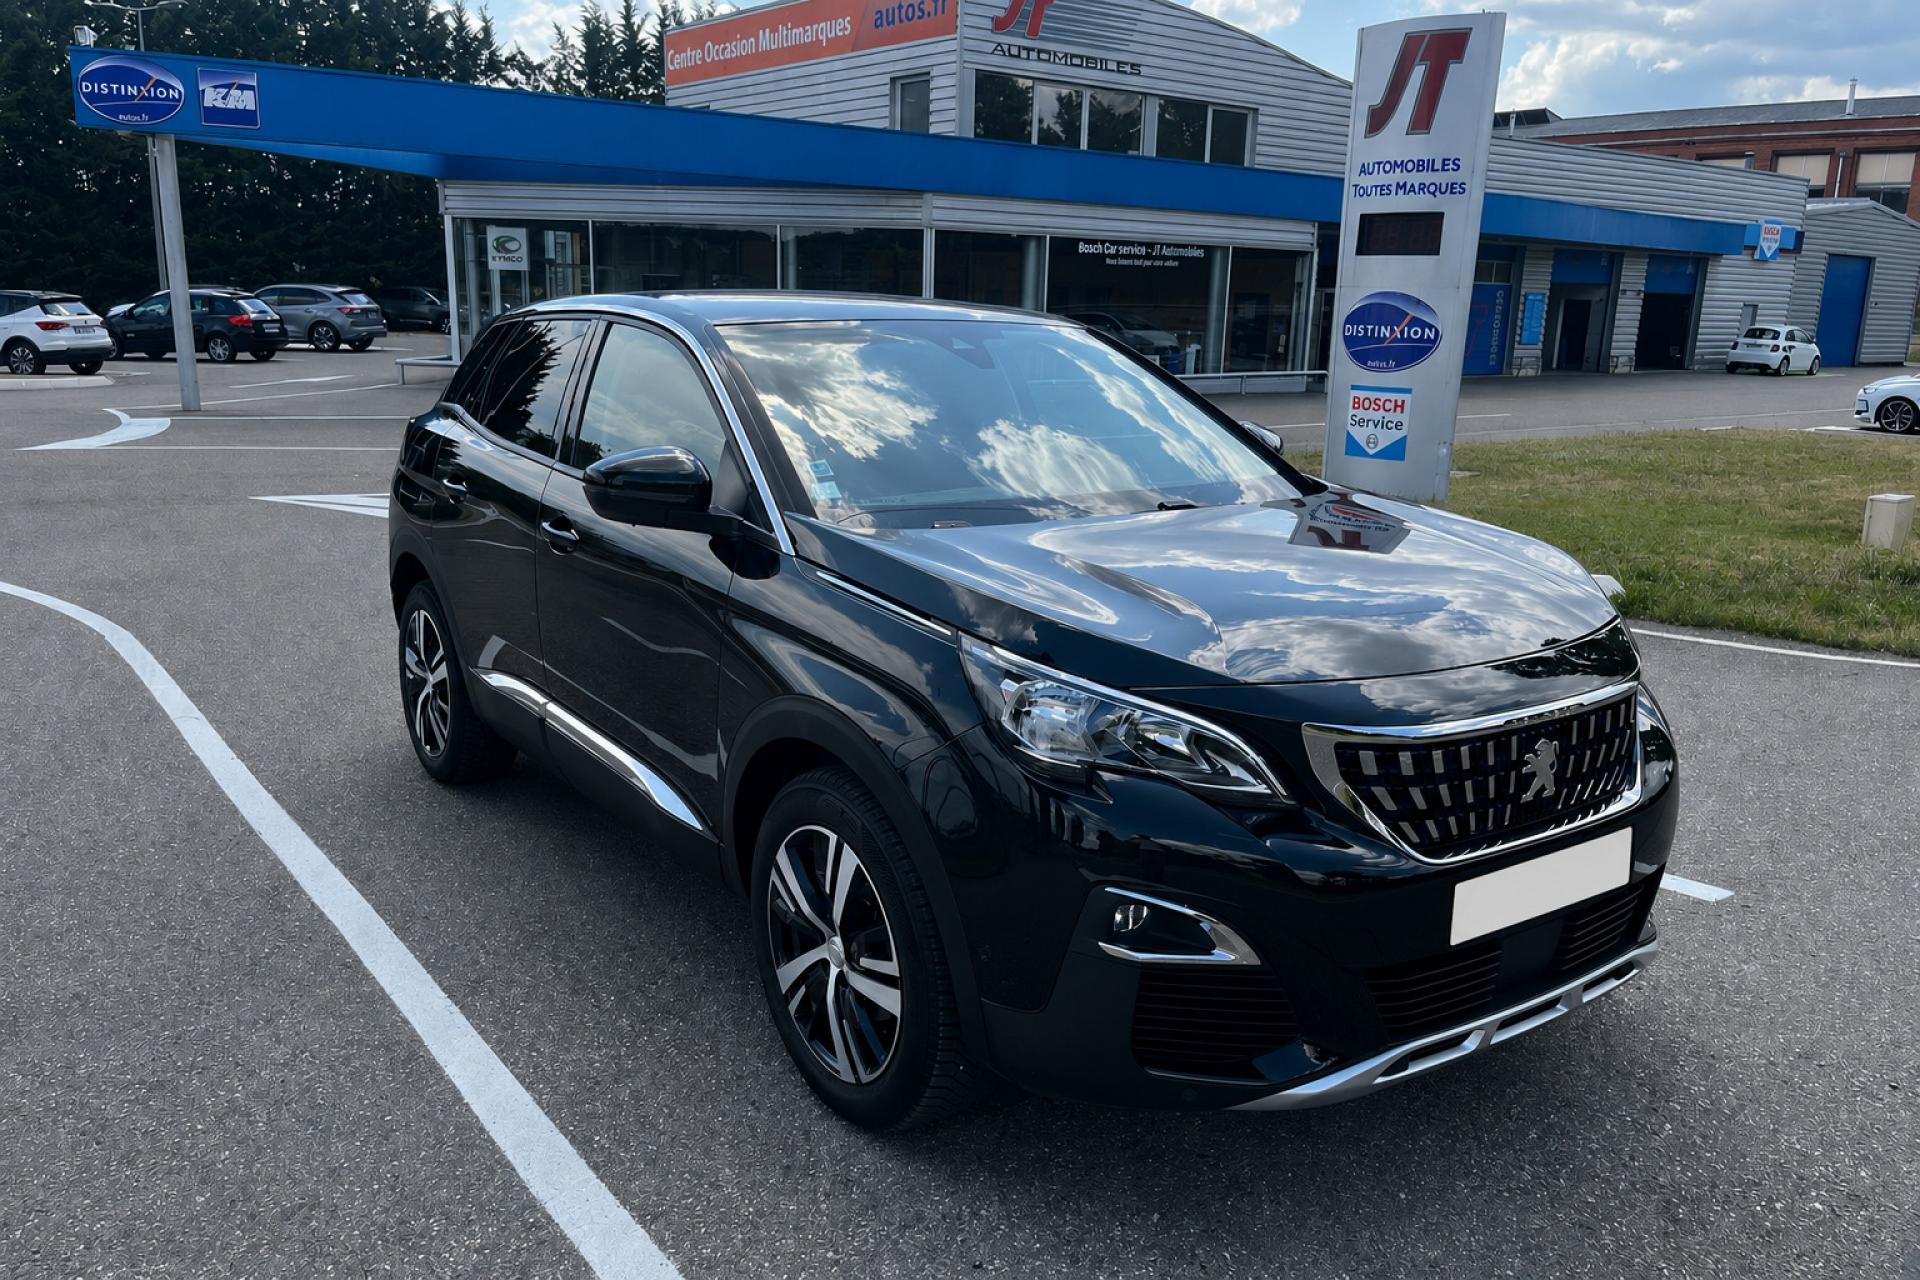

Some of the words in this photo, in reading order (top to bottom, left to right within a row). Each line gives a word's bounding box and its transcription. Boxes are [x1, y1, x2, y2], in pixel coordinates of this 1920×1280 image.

[668, 48, 702, 70] Centre
[704, 35, 755, 62] Occasion
[759, 16, 851, 52] Multimarques
[991, 43, 1142, 75] AUTOMOBILES
[82, 82, 179, 99] DISTINXION
[1364, 27, 1473, 139] JT
[1359, 157, 1461, 177] AUTOMOBILES
[1396, 181, 1466, 197] MARQUES
[1079, 241, 1102, 254] Bosch
[1345, 324, 1435, 339] DISTINXION
[1352, 396, 1405, 414] BOSCH
[1350, 414, 1403, 431] Service
